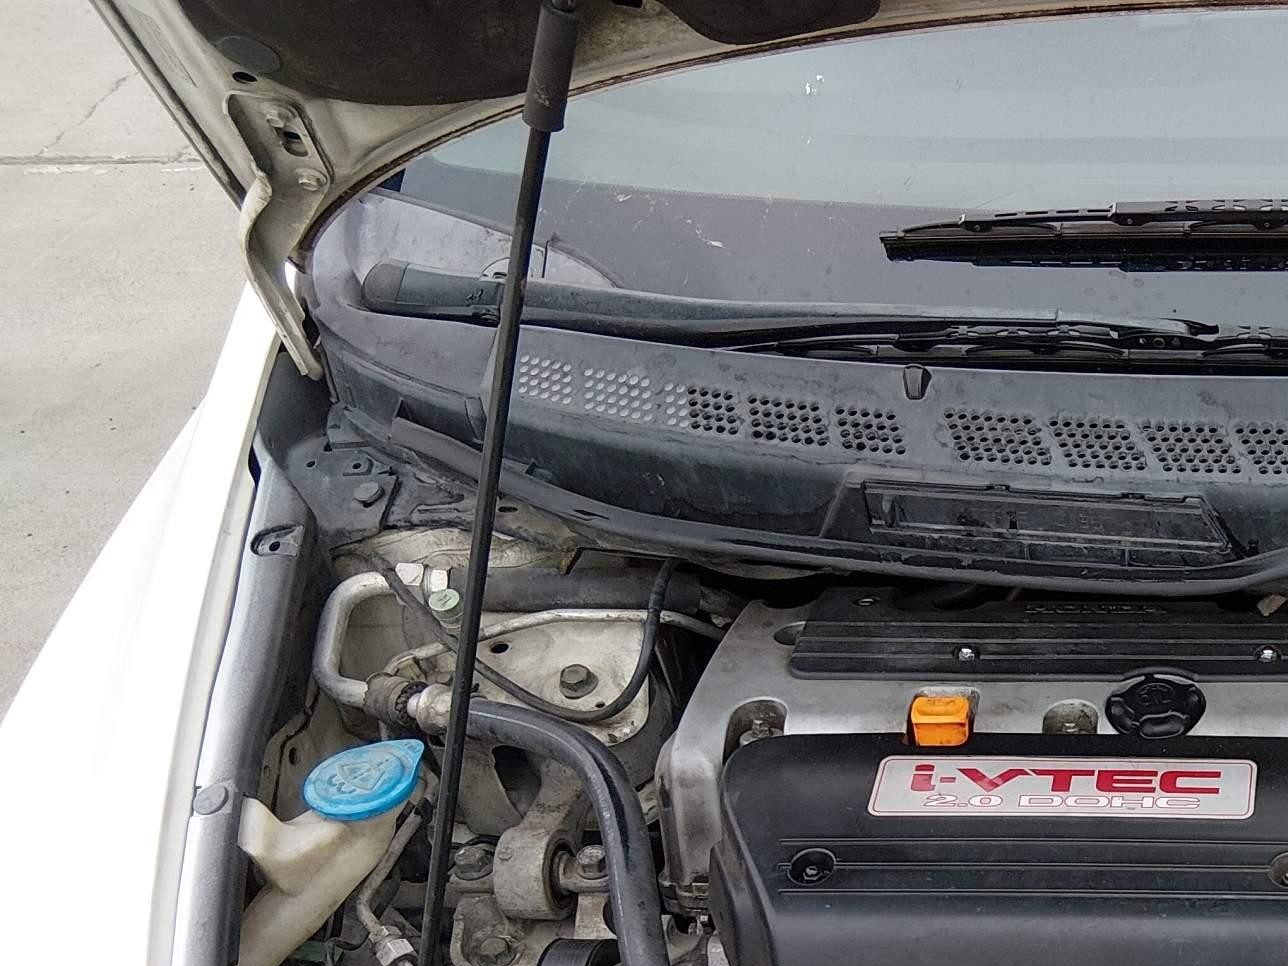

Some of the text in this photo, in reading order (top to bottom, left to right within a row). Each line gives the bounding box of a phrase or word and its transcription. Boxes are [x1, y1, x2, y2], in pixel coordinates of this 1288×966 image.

[910, 764, 1222, 796] i-VTEC
[923, 794, 1201, 810] 2.0 DOHC
